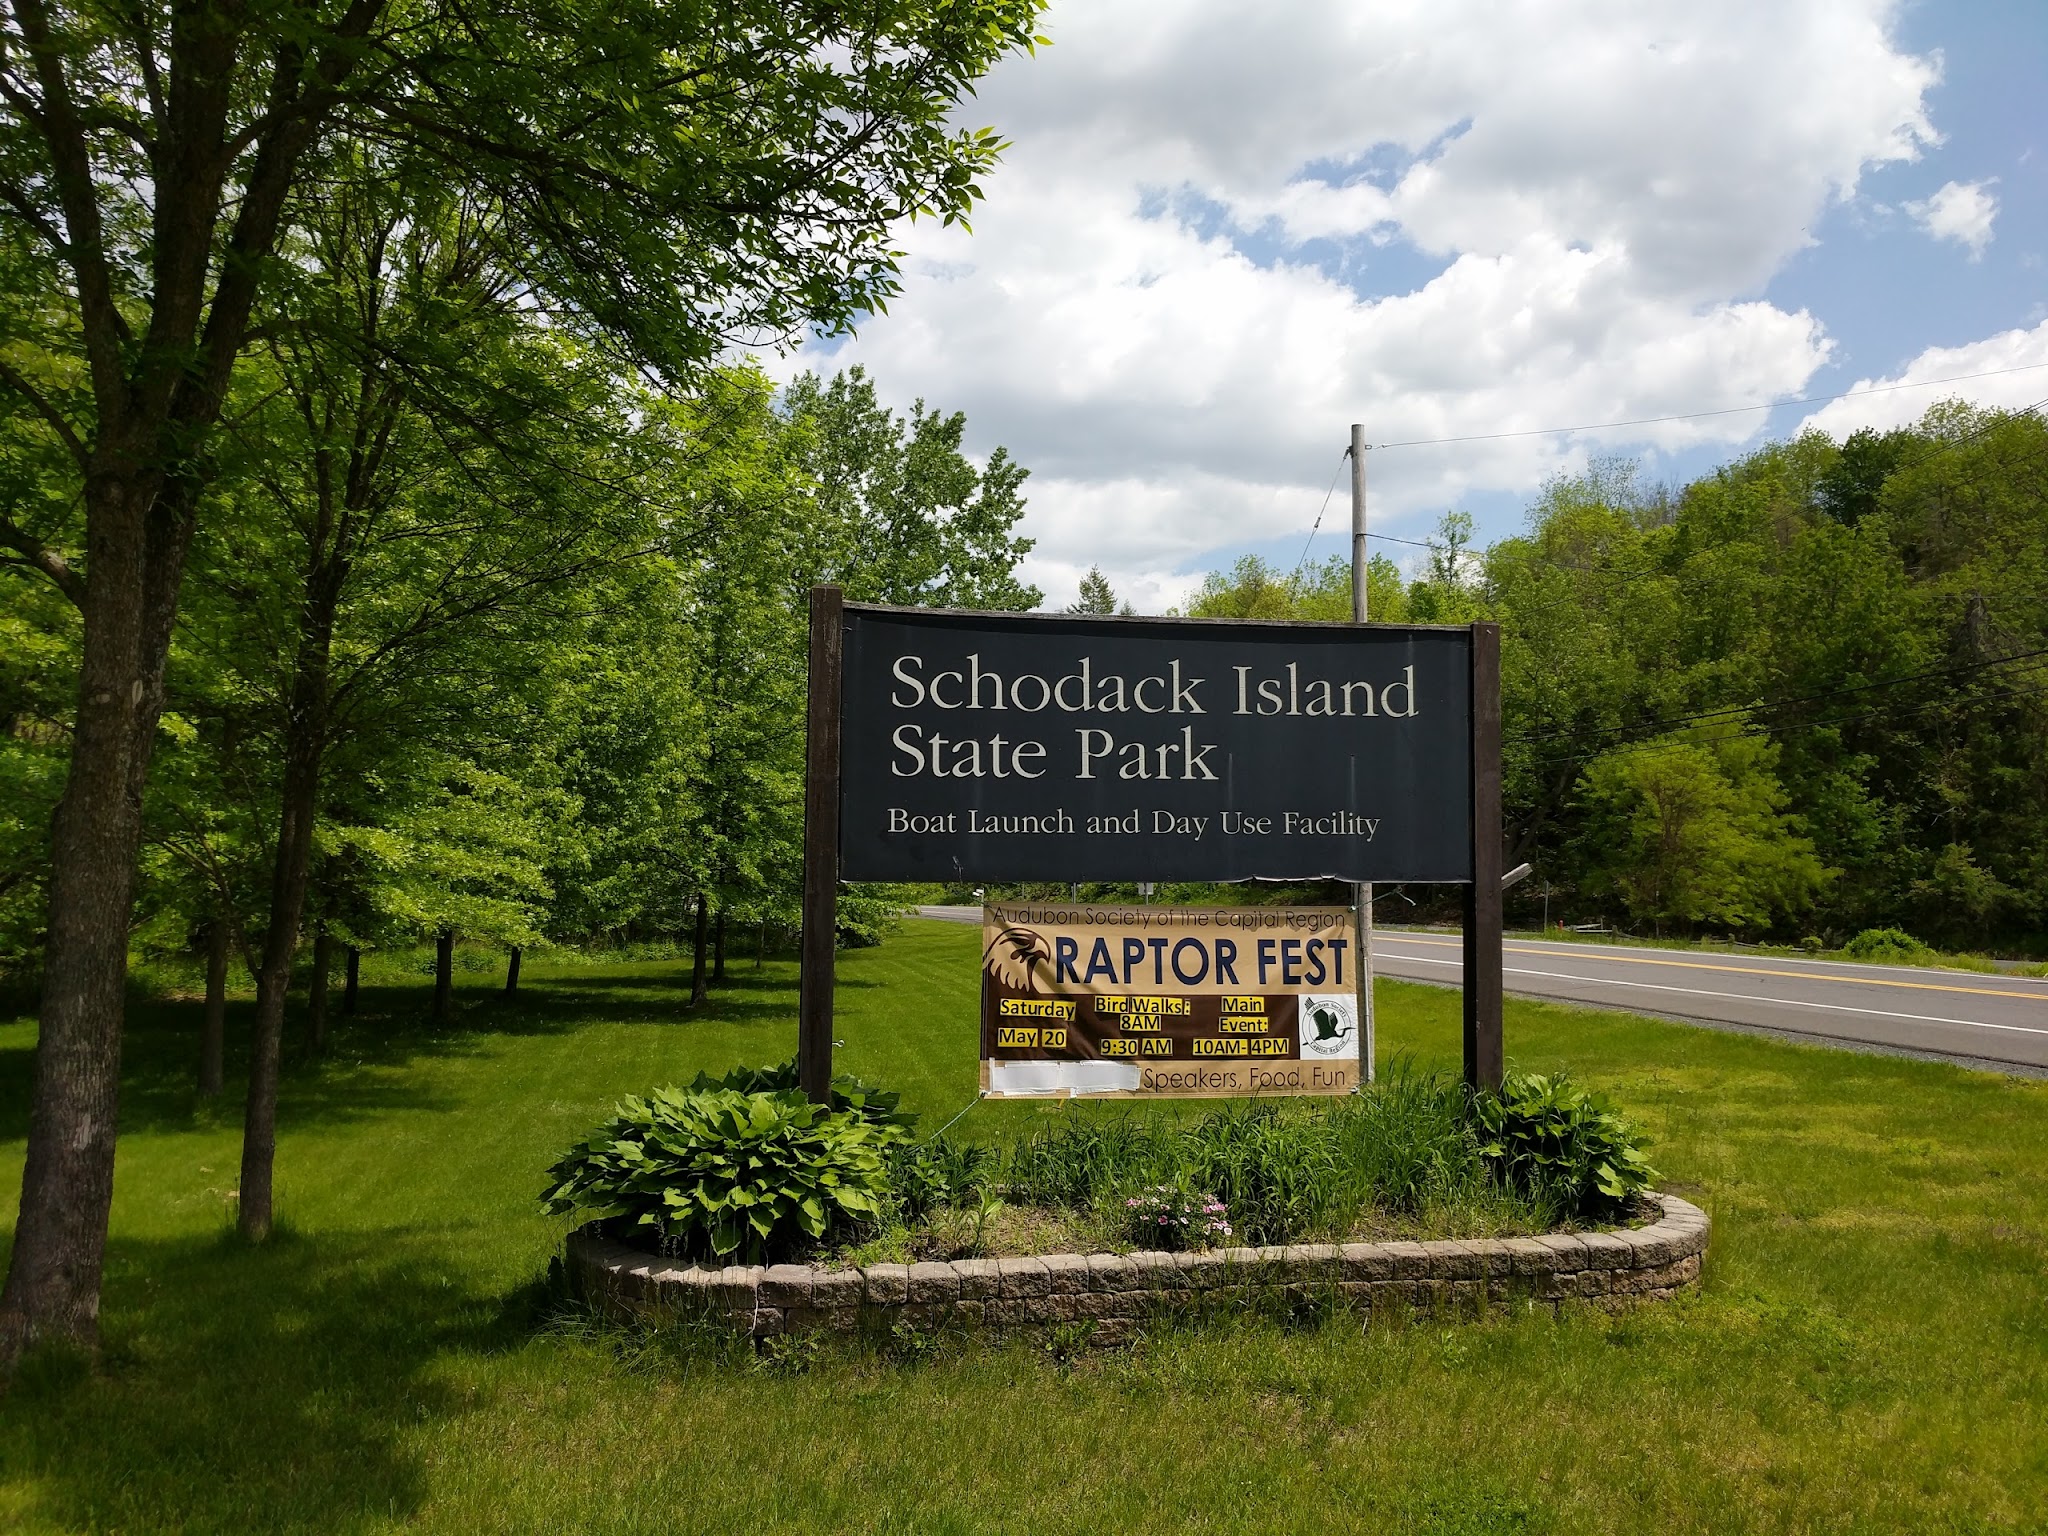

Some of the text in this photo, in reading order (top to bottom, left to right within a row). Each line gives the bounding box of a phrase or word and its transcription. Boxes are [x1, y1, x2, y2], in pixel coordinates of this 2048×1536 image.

[891, 653, 1419, 718] Schodack Island
[891, 724, 1219, 781] State Park
[887, 808, 1381, 842] Boat Launch and Day Use Facility
[993, 906, 1345, 932] Audubon Society of the Capital Region
[1055, 936, 1348, 986] RAPTOR FEST
[1001, 1000, 1075, 1019] Saturday
[1096, 997, 1129, 1013] Bird
[1223, 998, 1262, 1012] Main
[1121, 1015, 1160, 1030] 8AM
[1220, 1018, 1268, 1032] Event:
[999, 1029, 1065, 1047] May 20
[1101, 1040, 1172, 1054] 9:30 AM
[1194, 1039, 1288, 1054] 10AM- 4PM
[1143, 1067, 1345, 1092] Speakers, Food, Fun
